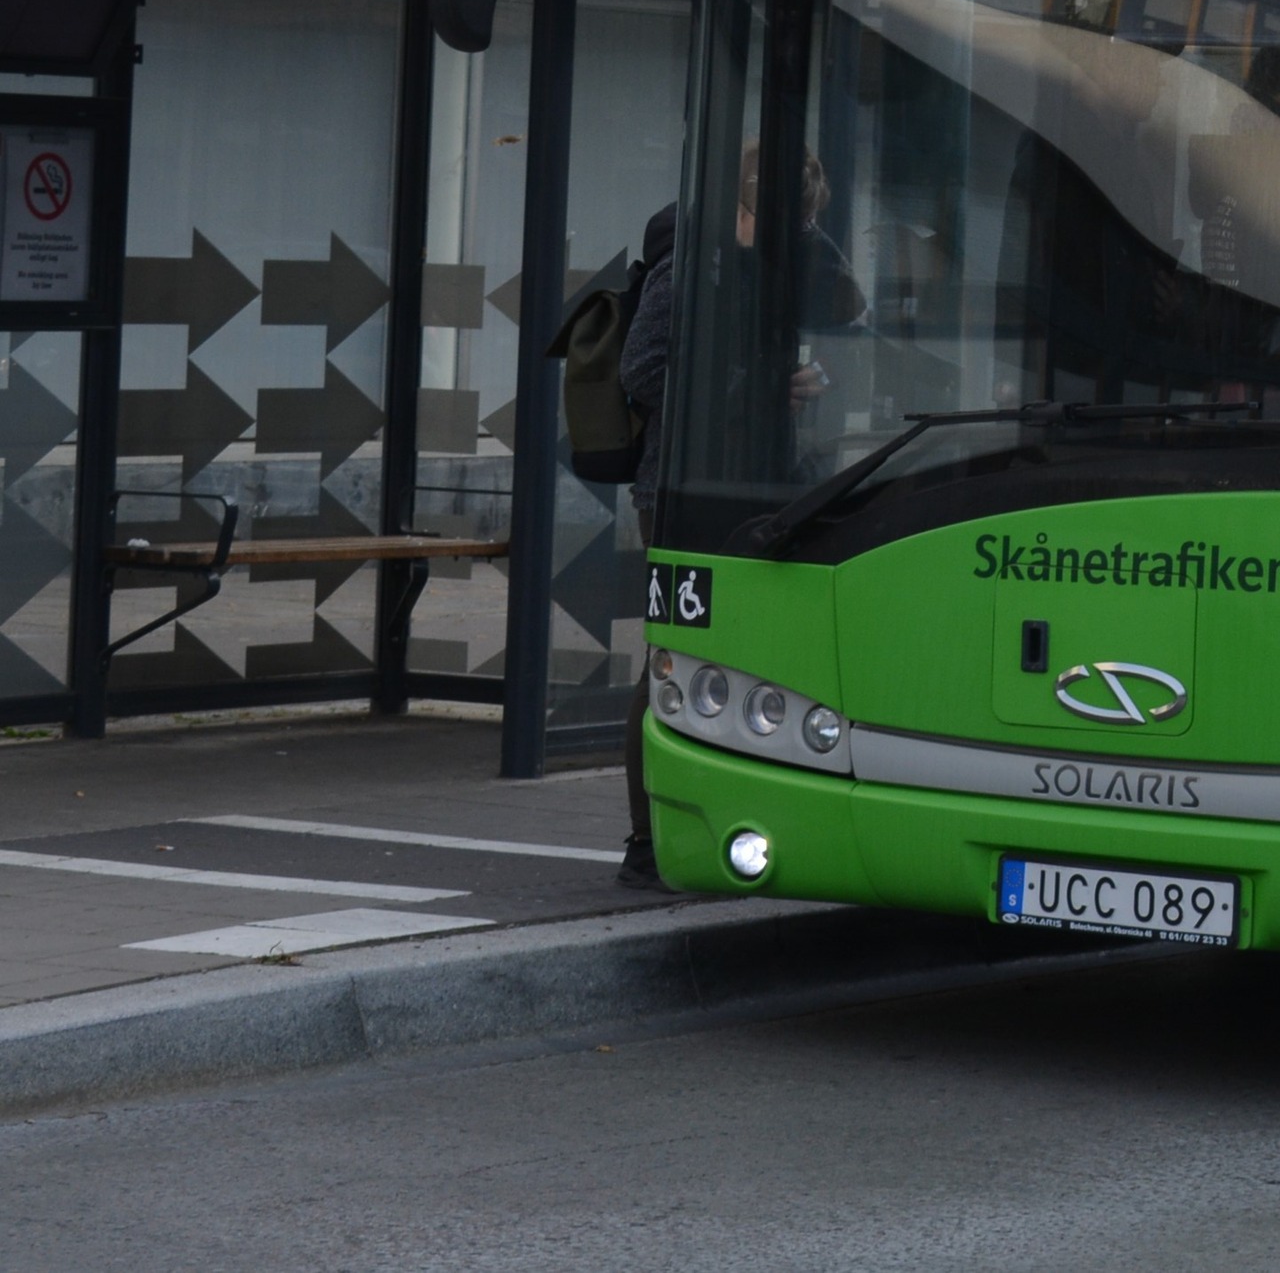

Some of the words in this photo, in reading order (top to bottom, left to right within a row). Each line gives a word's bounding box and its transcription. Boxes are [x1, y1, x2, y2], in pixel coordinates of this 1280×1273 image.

[1032, 763, 1201, 809] SOLARIS
[1020, 915, 1063, 928] SOLARIS
[1039, 869, 1117, 919] UCC
[1134, 880, 1215, 929] 089
